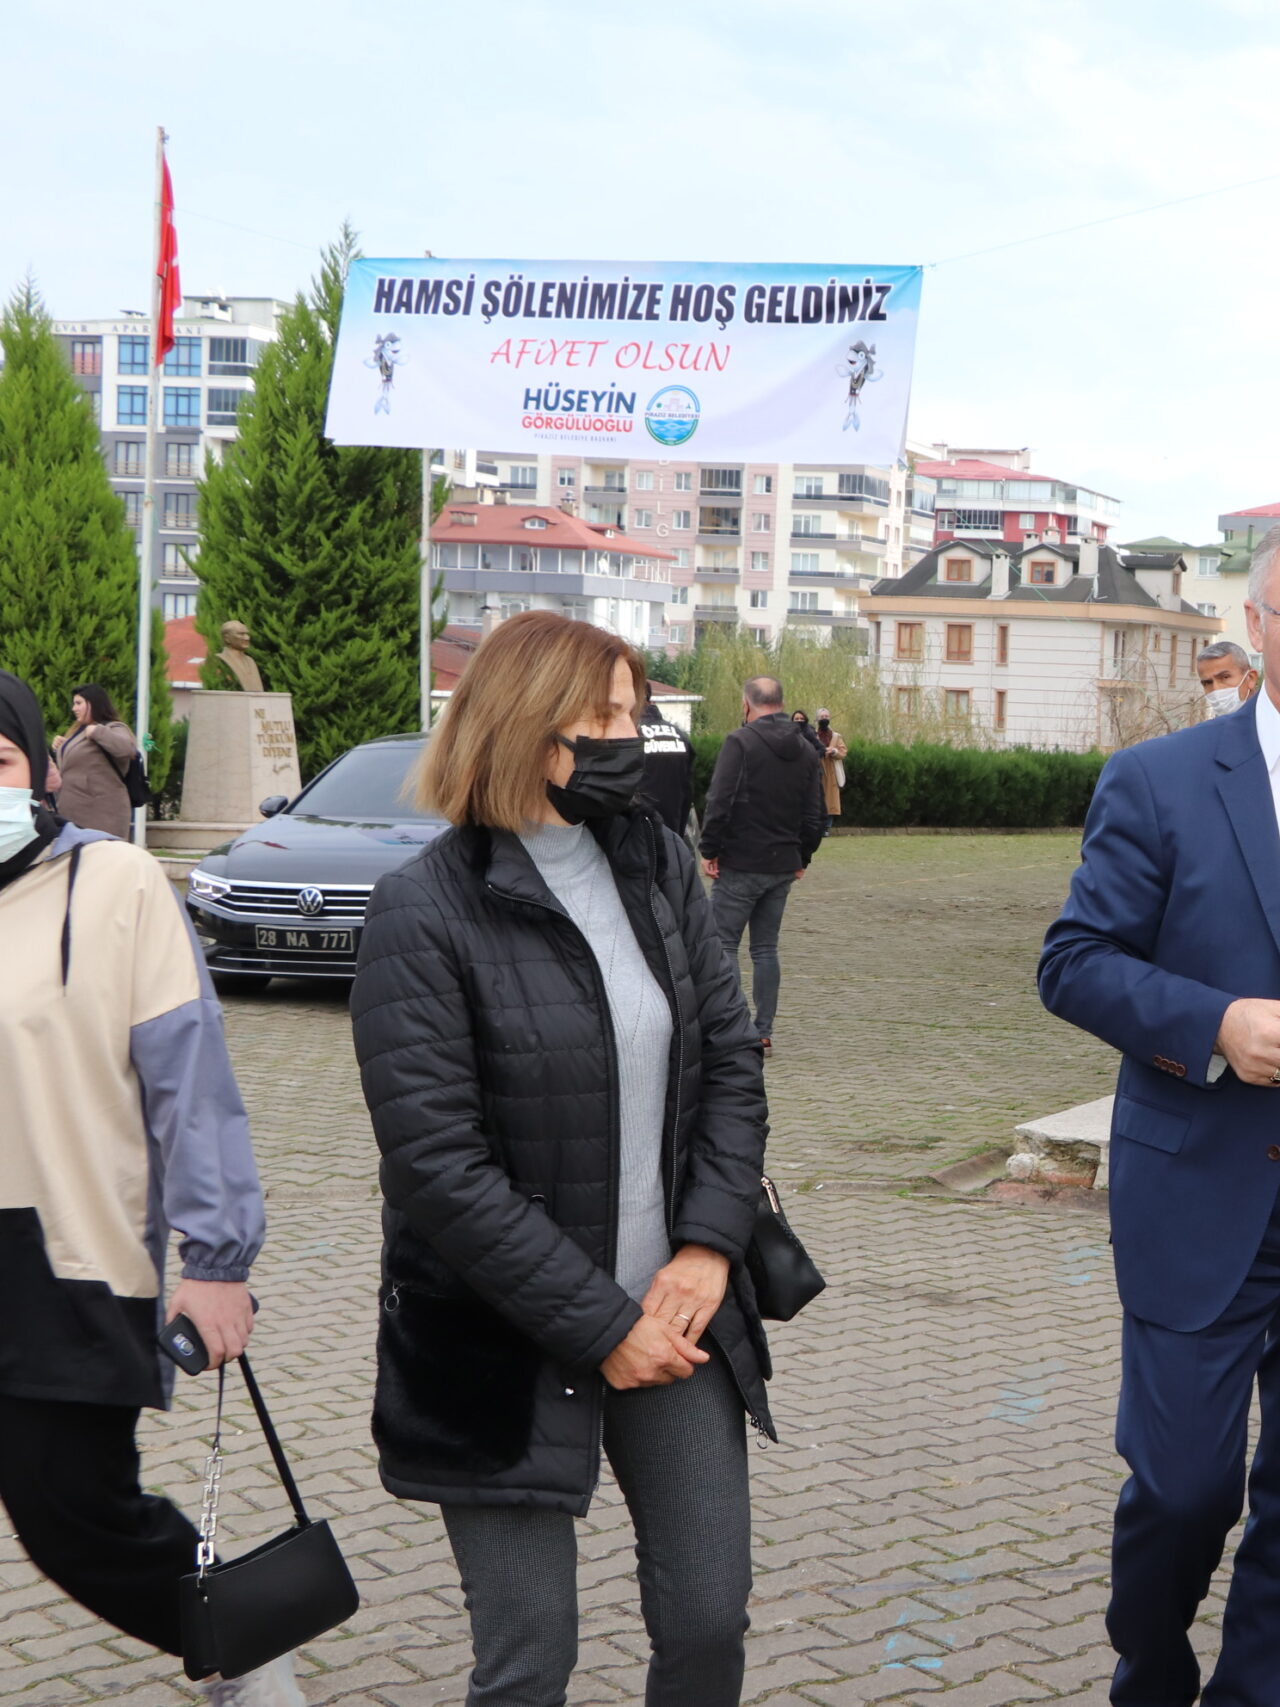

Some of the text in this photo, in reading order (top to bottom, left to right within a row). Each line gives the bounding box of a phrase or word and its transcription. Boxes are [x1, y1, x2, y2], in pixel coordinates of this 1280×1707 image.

[373, 273, 893, 331] HAMSİ ŞÖLENİMİZE HOŞ GELDİNİZ
[614, 340, 731, 373] OLSUN
[522, 381, 637, 414] HÜSEYİN
[521, 412, 633, 433] GÖRGÜLÜOĞLU
[640, 724, 681, 739] ÖZEL
[259, 930, 348, 949] 28 NA 777
